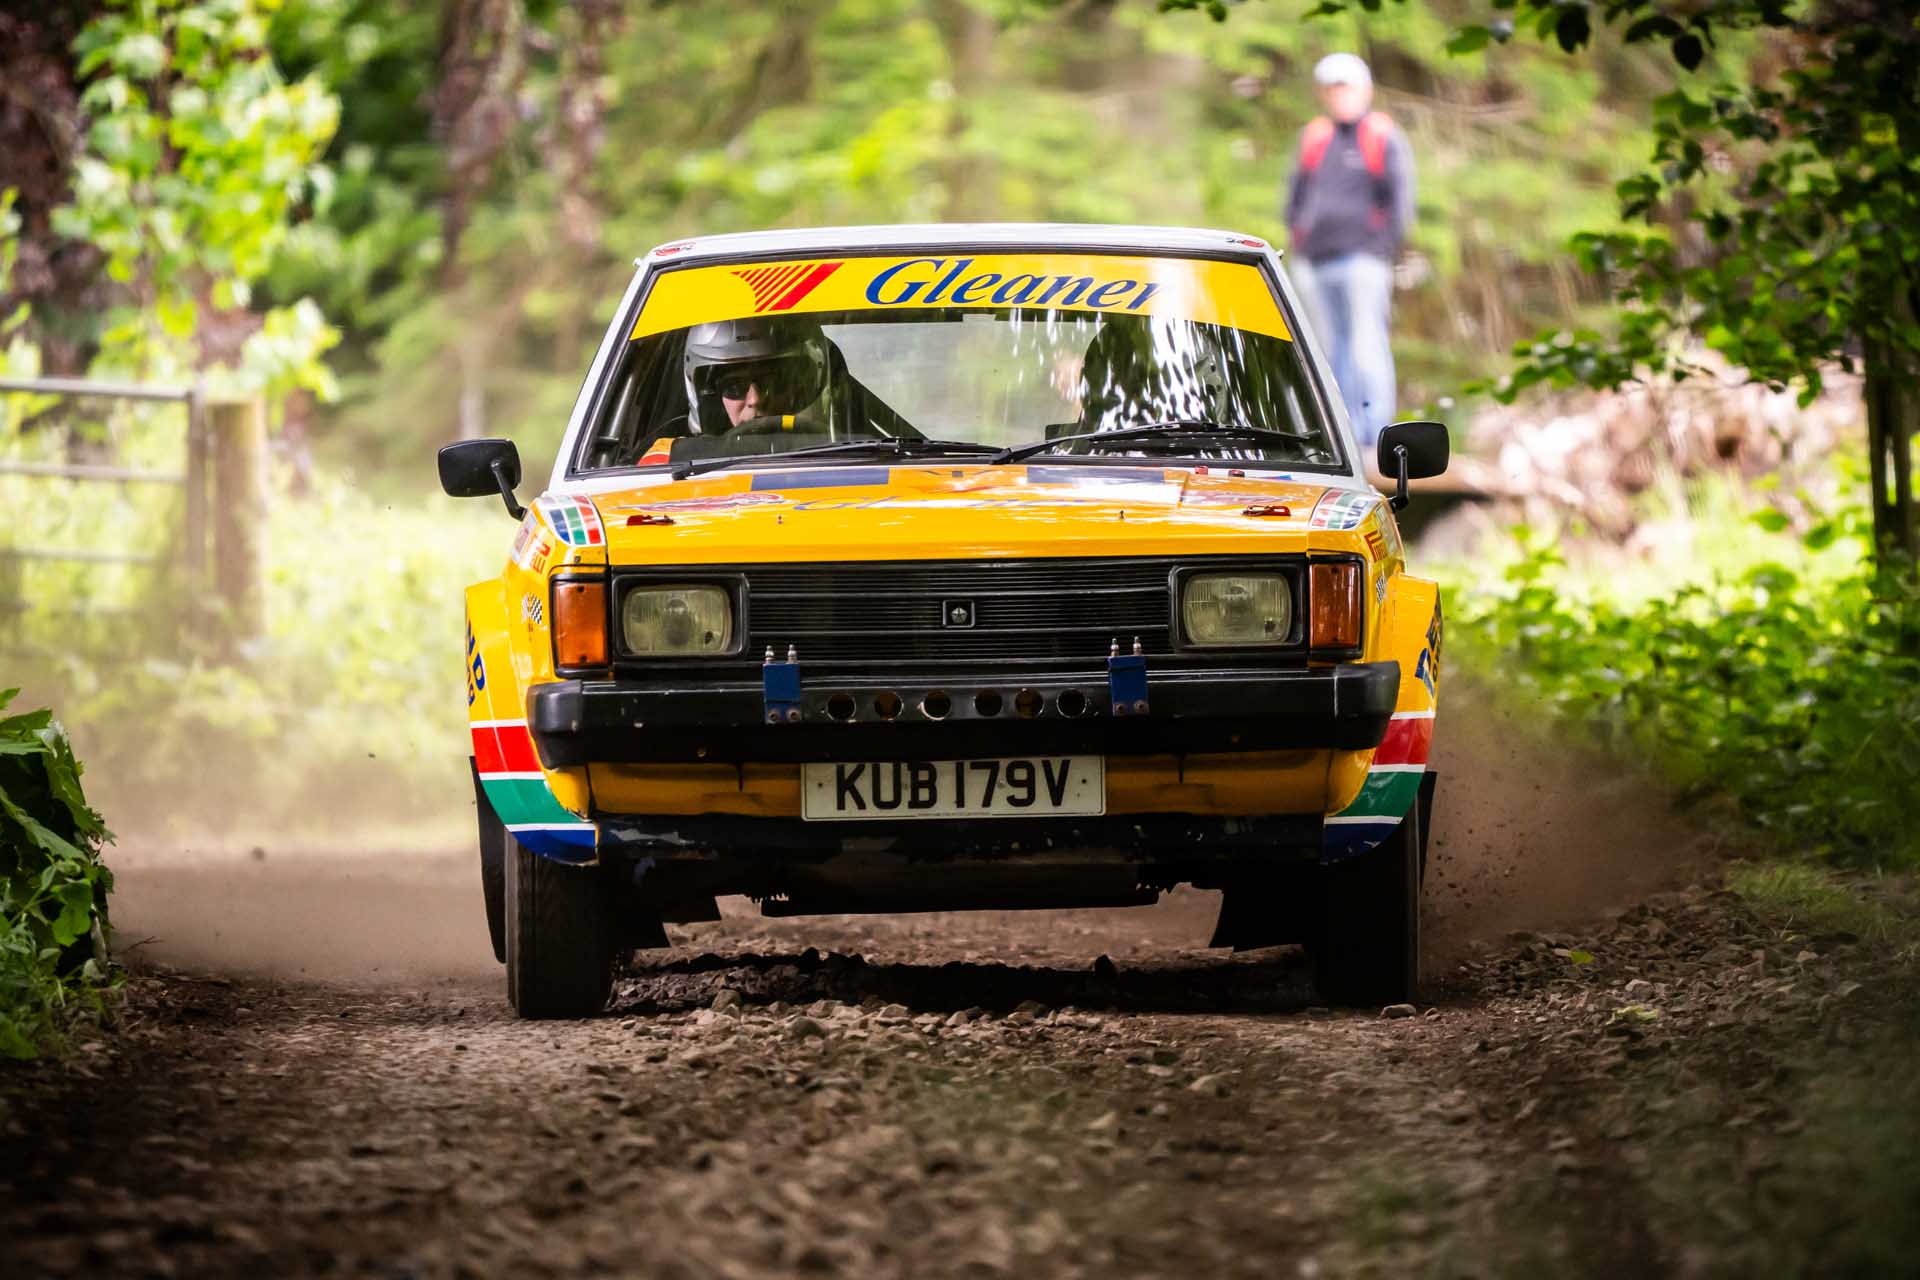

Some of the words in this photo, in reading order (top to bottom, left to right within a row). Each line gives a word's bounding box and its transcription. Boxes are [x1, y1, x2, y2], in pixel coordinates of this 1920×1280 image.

[865, 257, 1161, 311] Gleaner
[835, 761, 938, 811] KUB
[954, 758, 1072, 809] 179V
